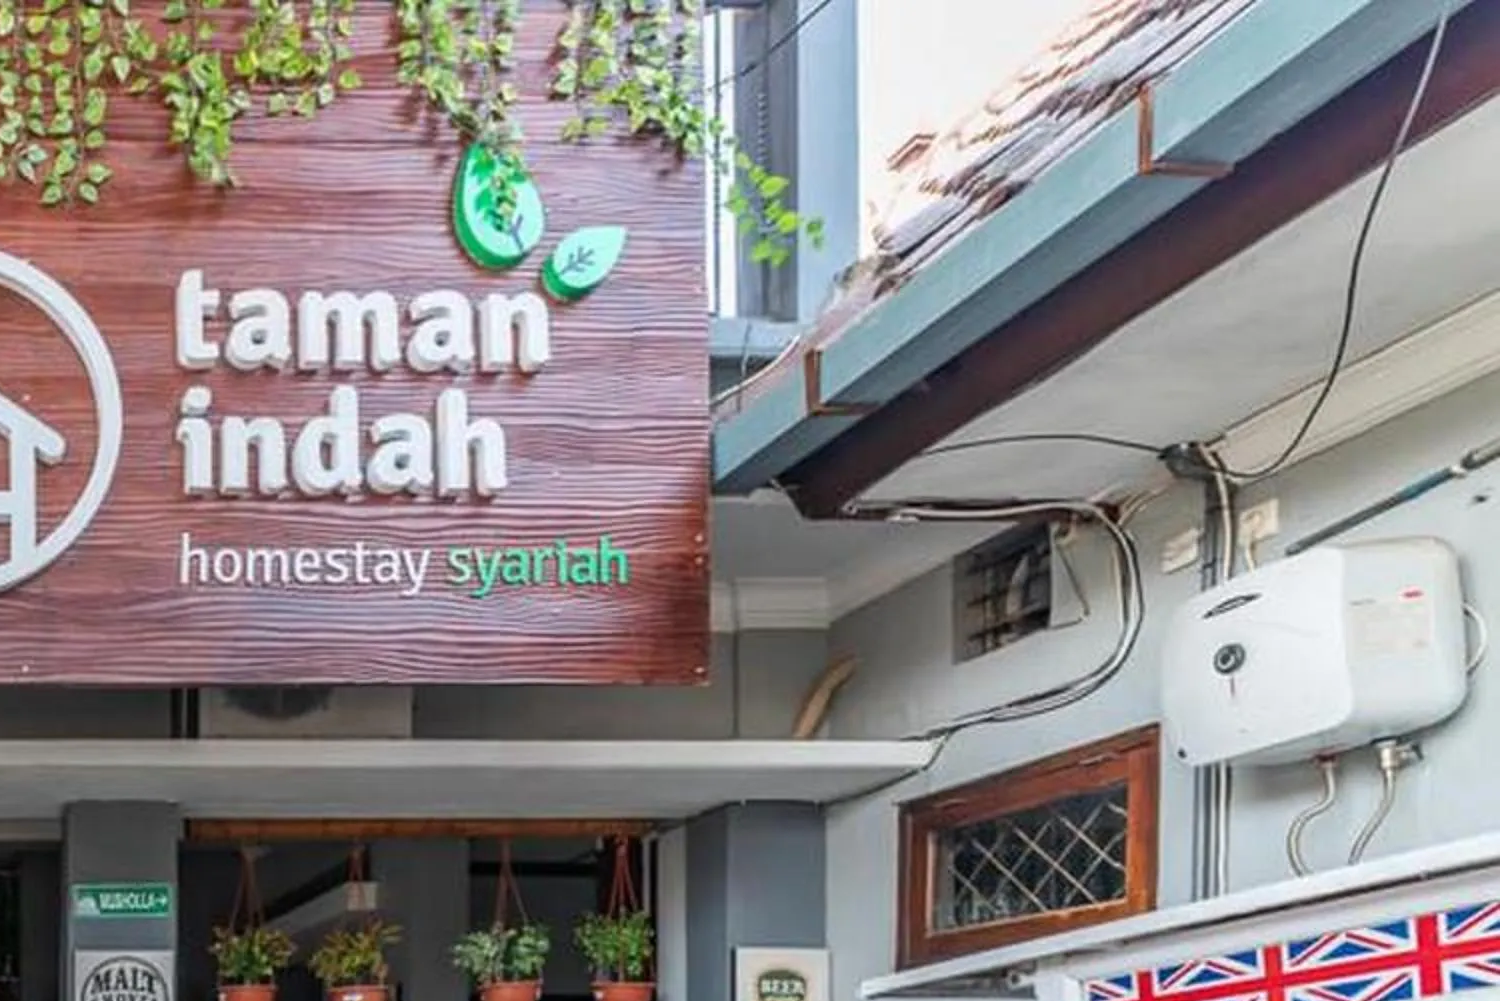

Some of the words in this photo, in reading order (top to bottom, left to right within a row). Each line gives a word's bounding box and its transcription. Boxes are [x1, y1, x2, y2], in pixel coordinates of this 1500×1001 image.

[175, 268, 551, 374] taman
[176, 385, 508, 499] indah
[179, 531, 432, 596] homestay
[446, 533, 629, 597] syariah
[90, 967, 156, 994] MALT
[761, 979, 805, 994] BEER
